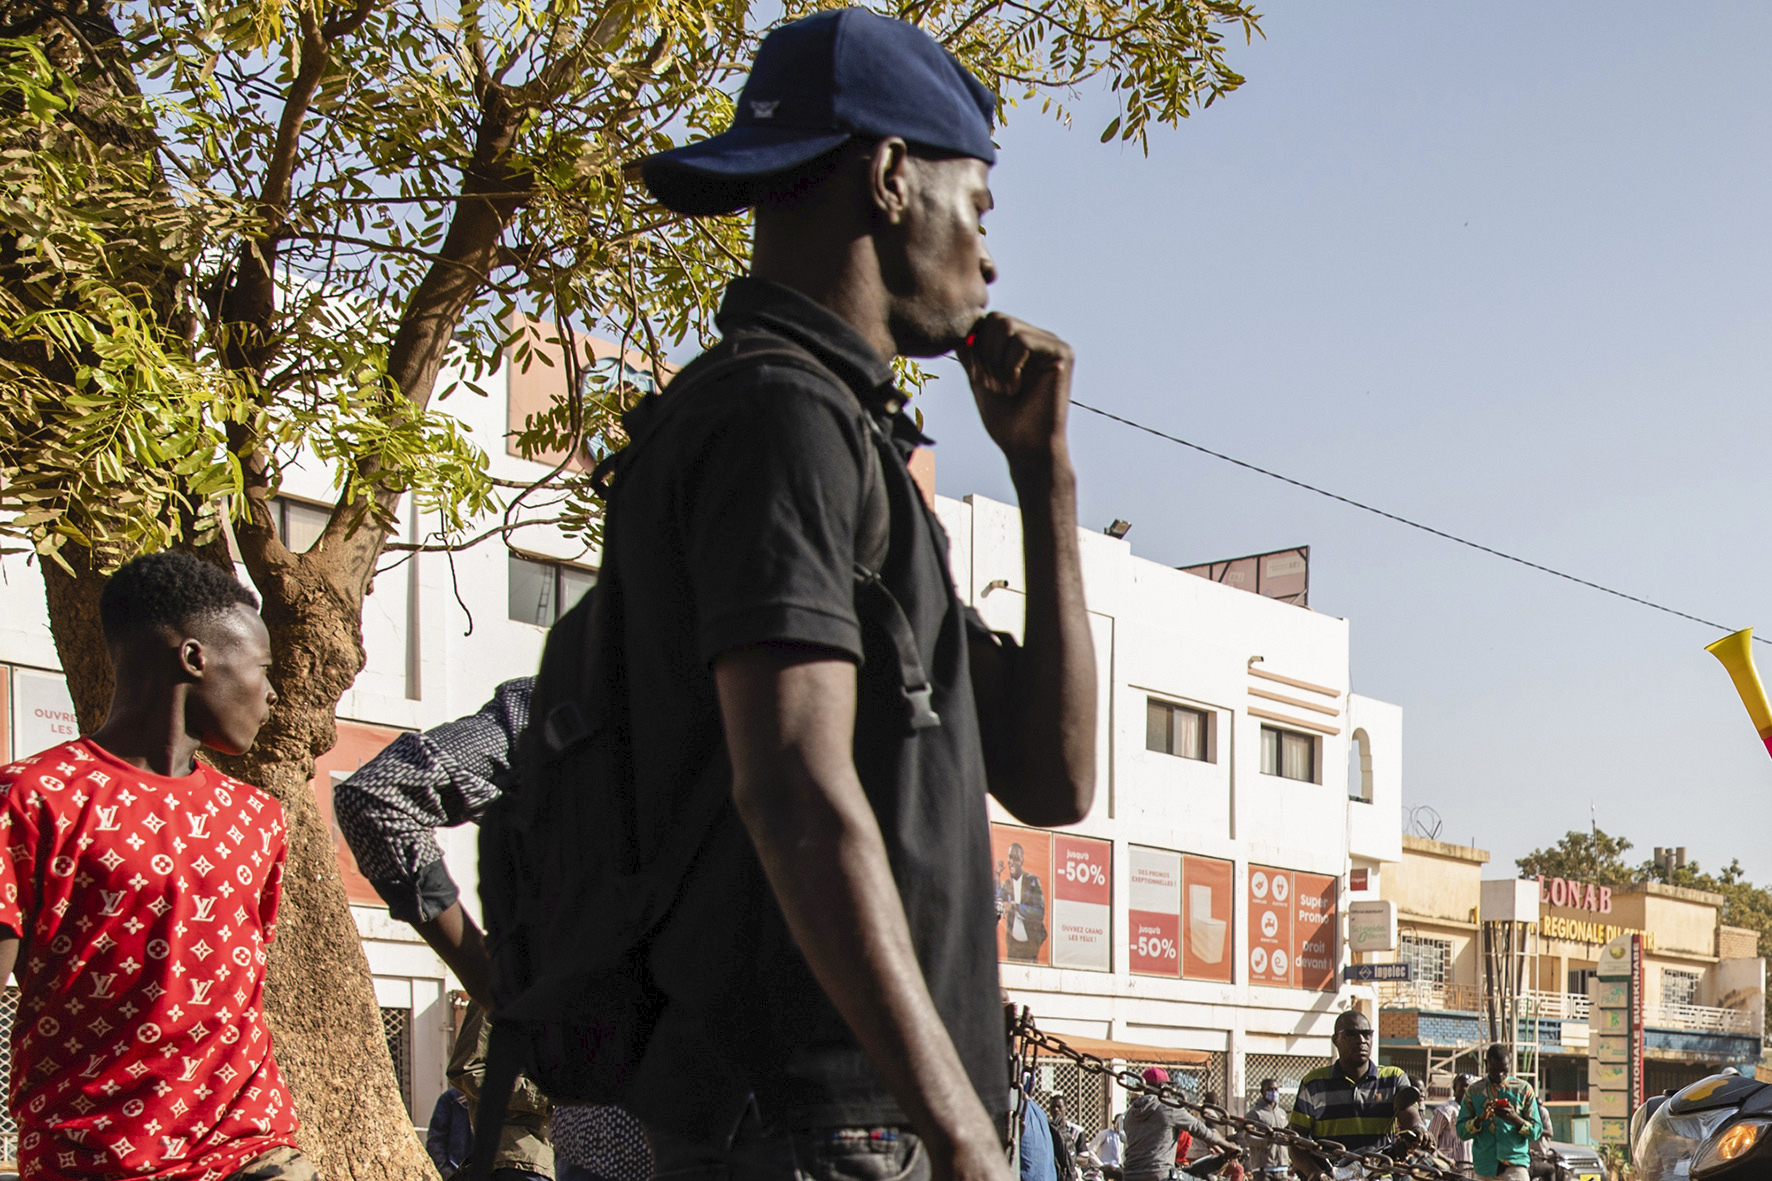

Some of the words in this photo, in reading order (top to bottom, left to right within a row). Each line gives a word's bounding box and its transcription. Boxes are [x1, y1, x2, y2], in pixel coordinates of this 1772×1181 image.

[34, 708, 77, 723] OUVRE
[51, 723, 73, 735] LES
[1057, 861, 1105, 885] -50%
[1300, 894, 1328, 910] Super
[1537, 875, 1612, 914] LONAB
[1299, 910, 1329, 924] Promo
[1062, 924, 1083, 934] OUVREZ
[1085, 927, 1103, 936] GRAND
[1544, 915, 1604, 944] REGIONALE
[1130, 936, 1176, 959] -50%
[1303, 940, 1325, 954] Droit
[1295, 955, 1327, 970] devant
[1633, 1030, 1641, 1109] NATIONALE
